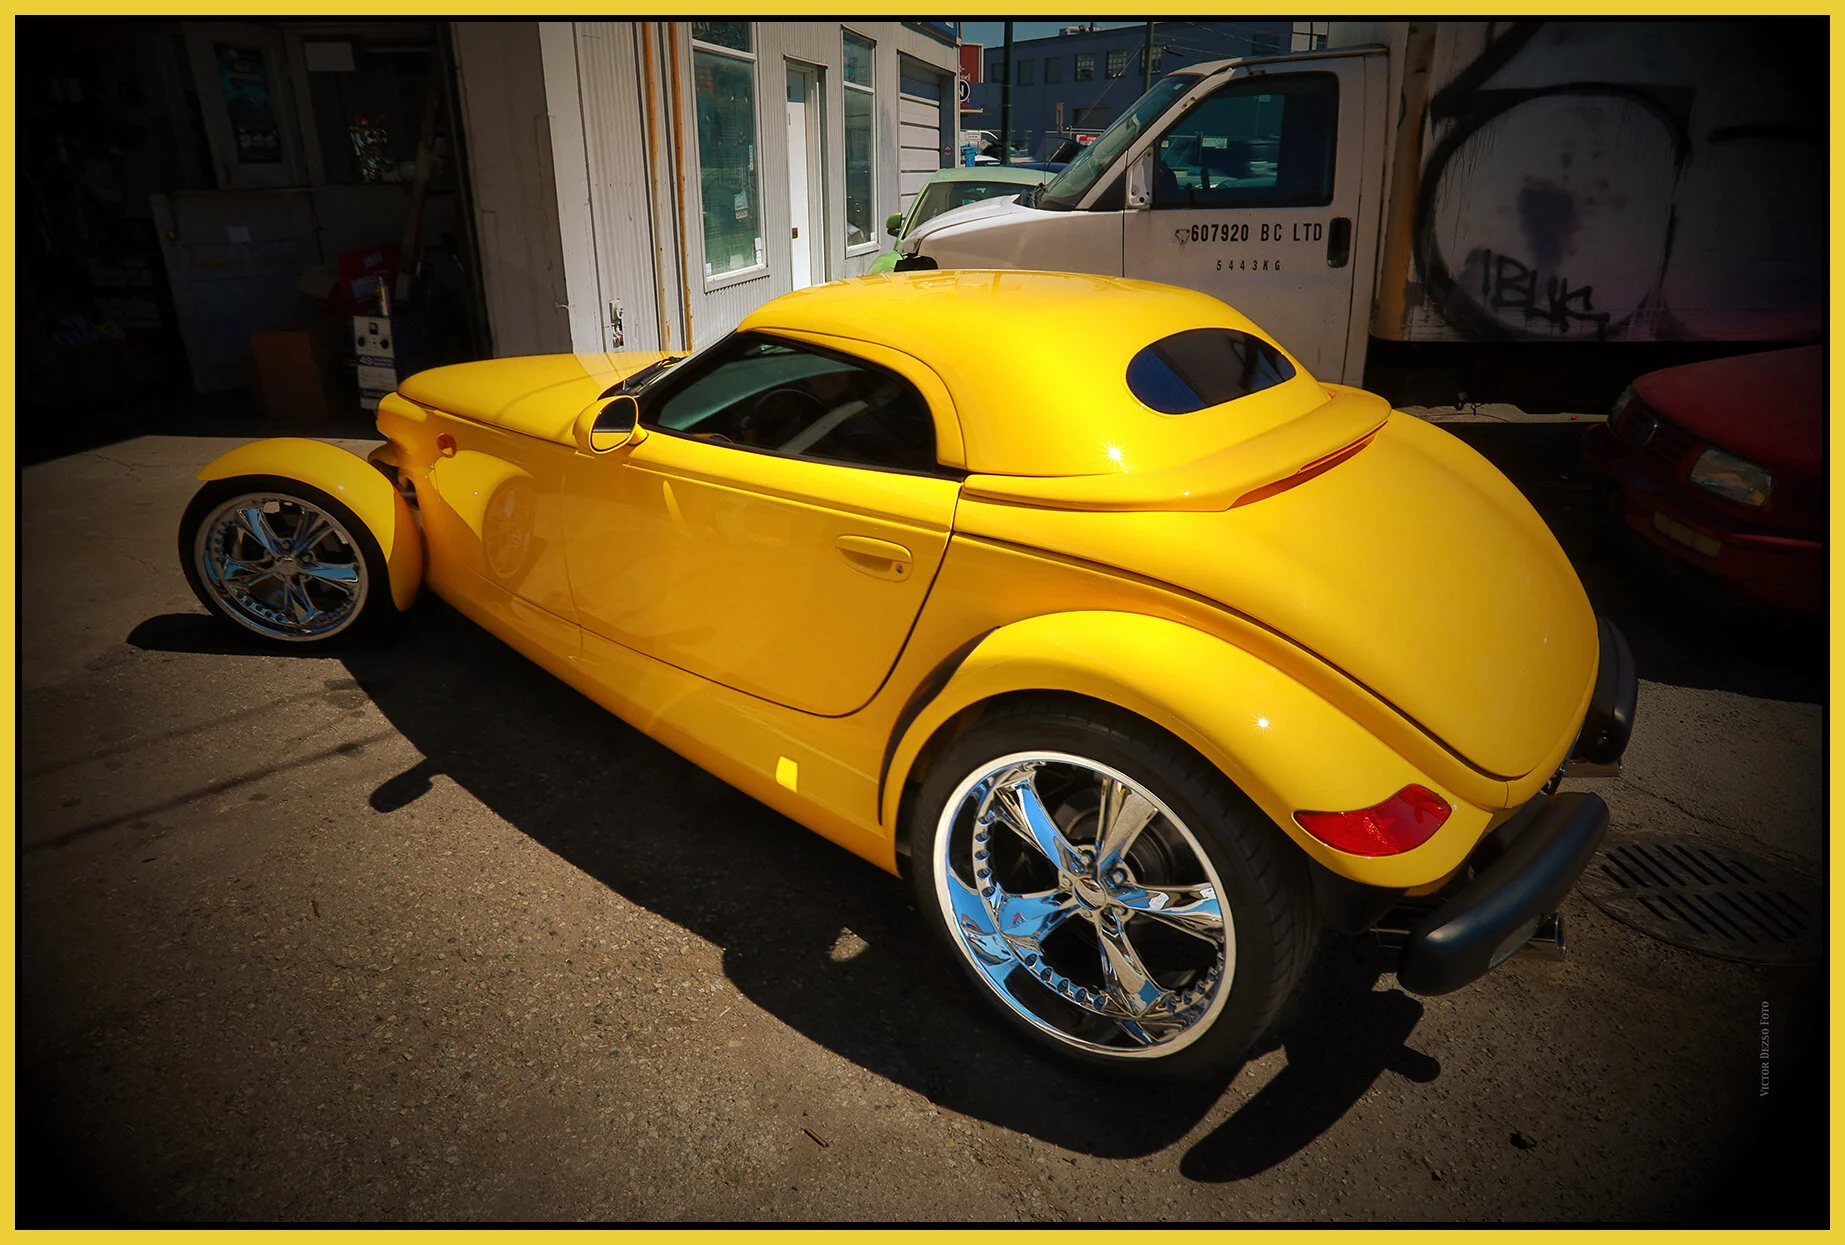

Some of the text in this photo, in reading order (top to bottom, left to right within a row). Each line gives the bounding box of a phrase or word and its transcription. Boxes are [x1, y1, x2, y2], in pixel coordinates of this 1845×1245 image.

[1191, 222, 1323, 242] 607920 BC LTD
